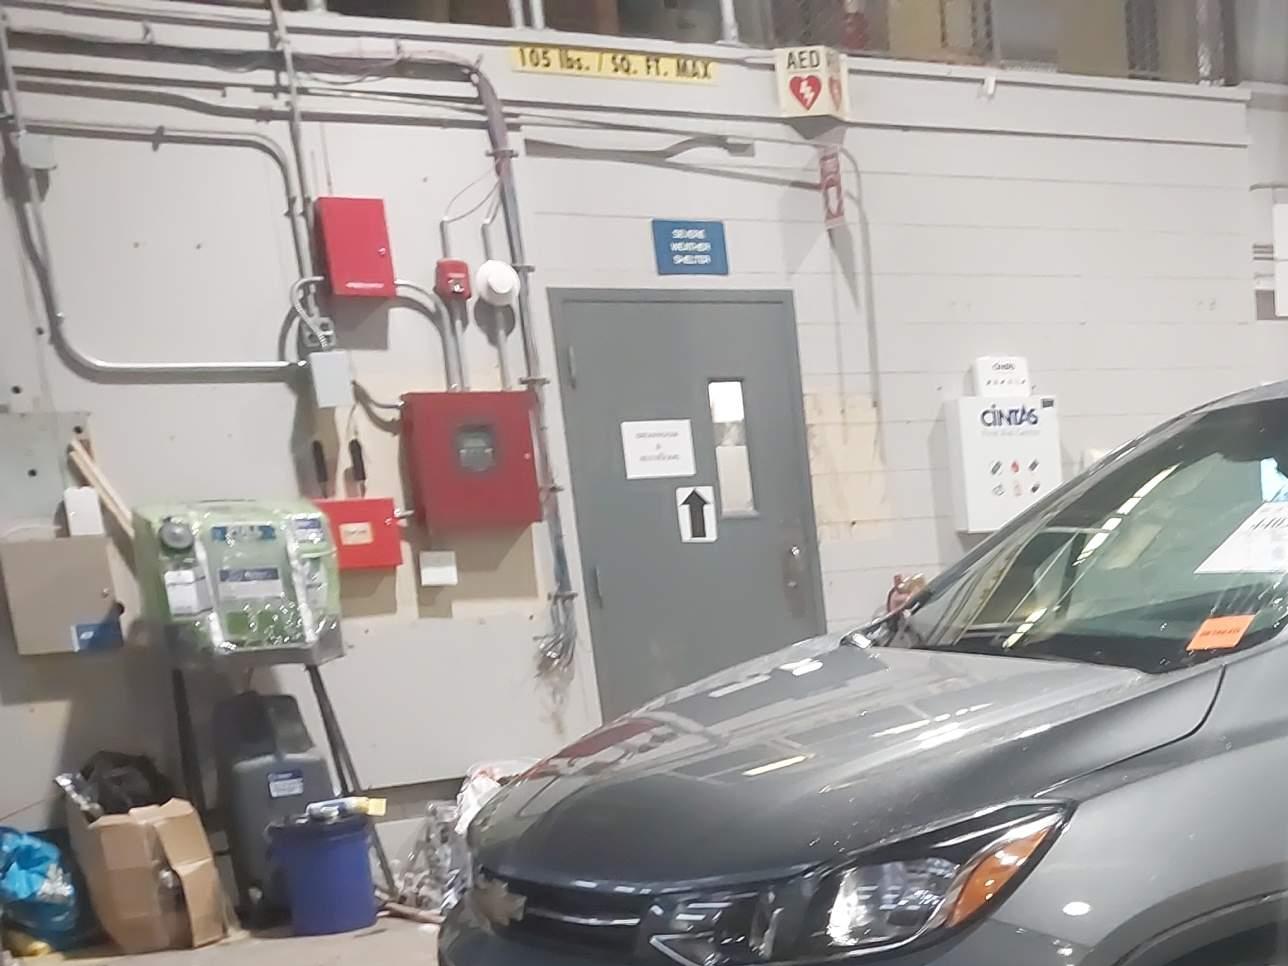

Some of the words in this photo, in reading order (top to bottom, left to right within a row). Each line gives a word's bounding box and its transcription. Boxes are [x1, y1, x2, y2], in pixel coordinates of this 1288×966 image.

[519, 48, 551, 68] 105
[559, 49, 590, 71] lbs.
[611, 55, 638, 75] SQ.
[646, 57, 669, 76] FT.
[787, 49, 820, 69] AED
